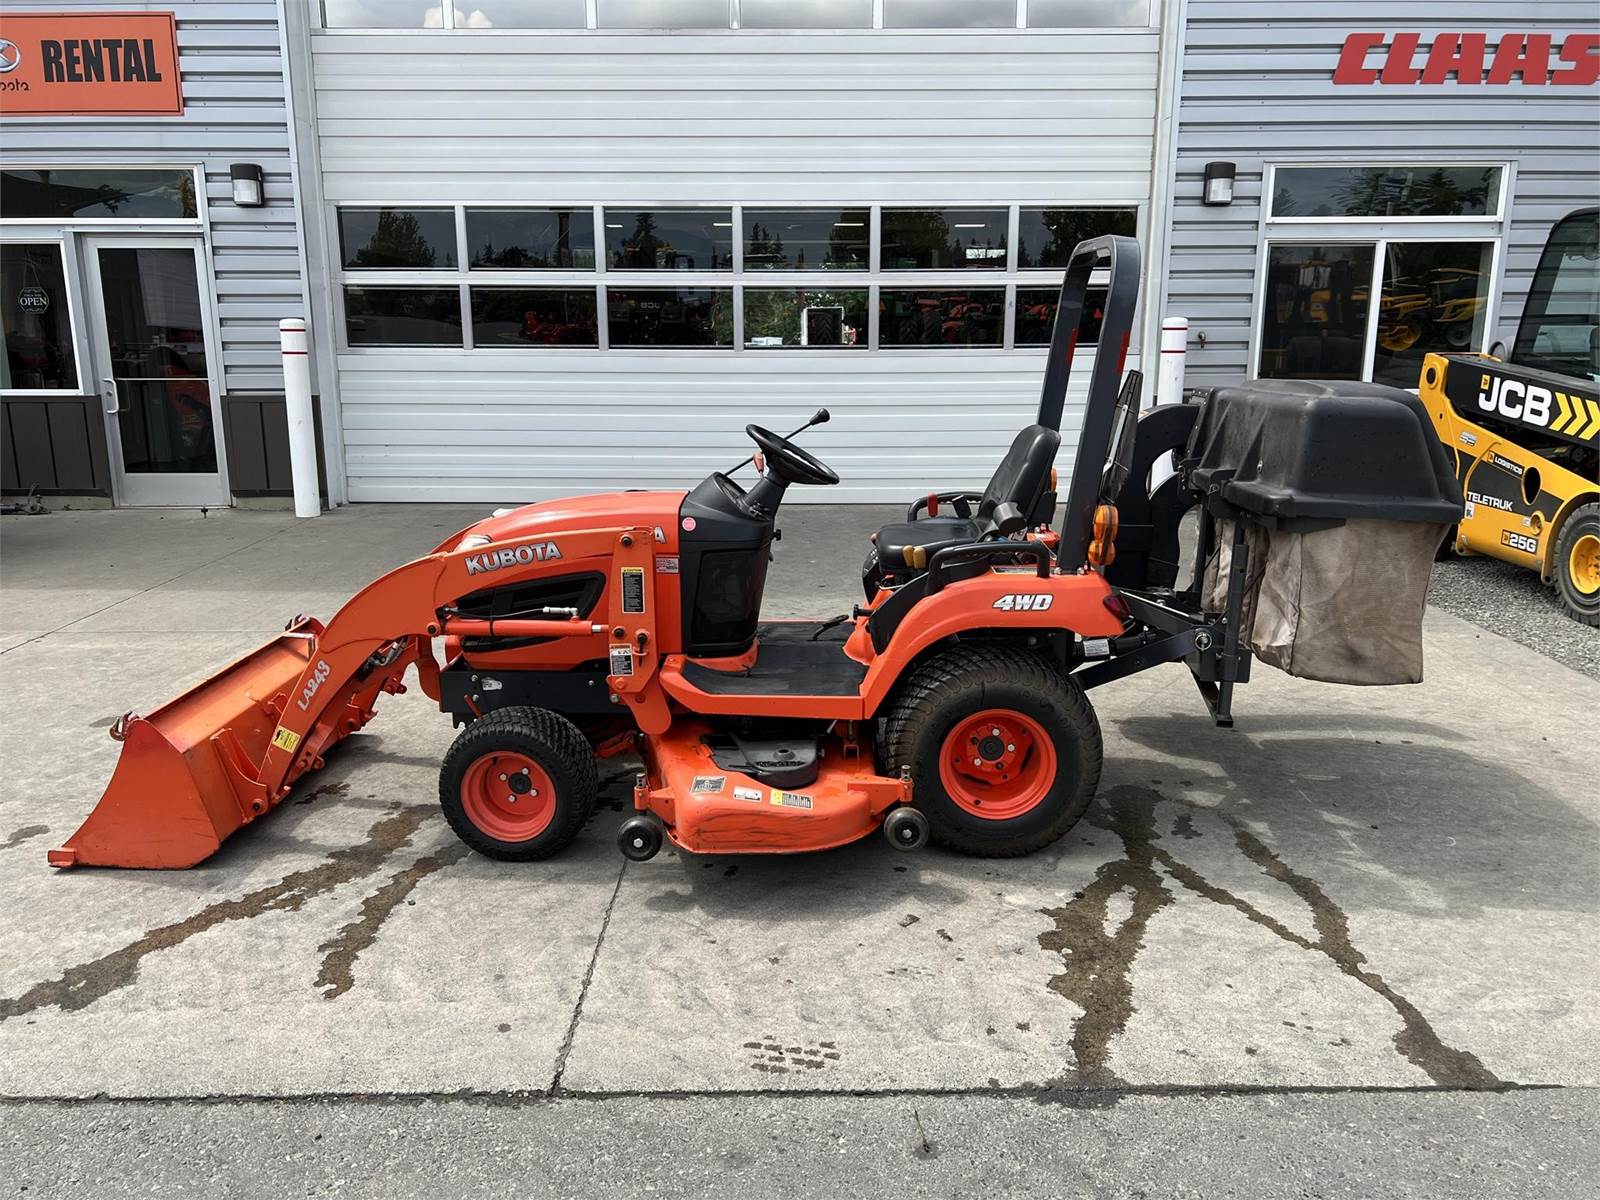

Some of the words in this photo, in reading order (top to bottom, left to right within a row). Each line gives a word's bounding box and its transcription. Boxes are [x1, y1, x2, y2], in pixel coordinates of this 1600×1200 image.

[40, 39, 162, 83] RENTAL
[1332, 33, 1600, 85] CLAAS
[20, 297, 47, 306] OPEN
[1478, 376, 1552, 427] JCB
[1494, 456, 1523, 475] LOGISTICS
[1467, 491, 1514, 512] TELETRUK
[1509, 533, 1537, 553] 25G
[465, 541, 563, 576] KUBOTA
[992, 594, 1054, 611] 4WD
[297, 660, 331, 711] LA243
